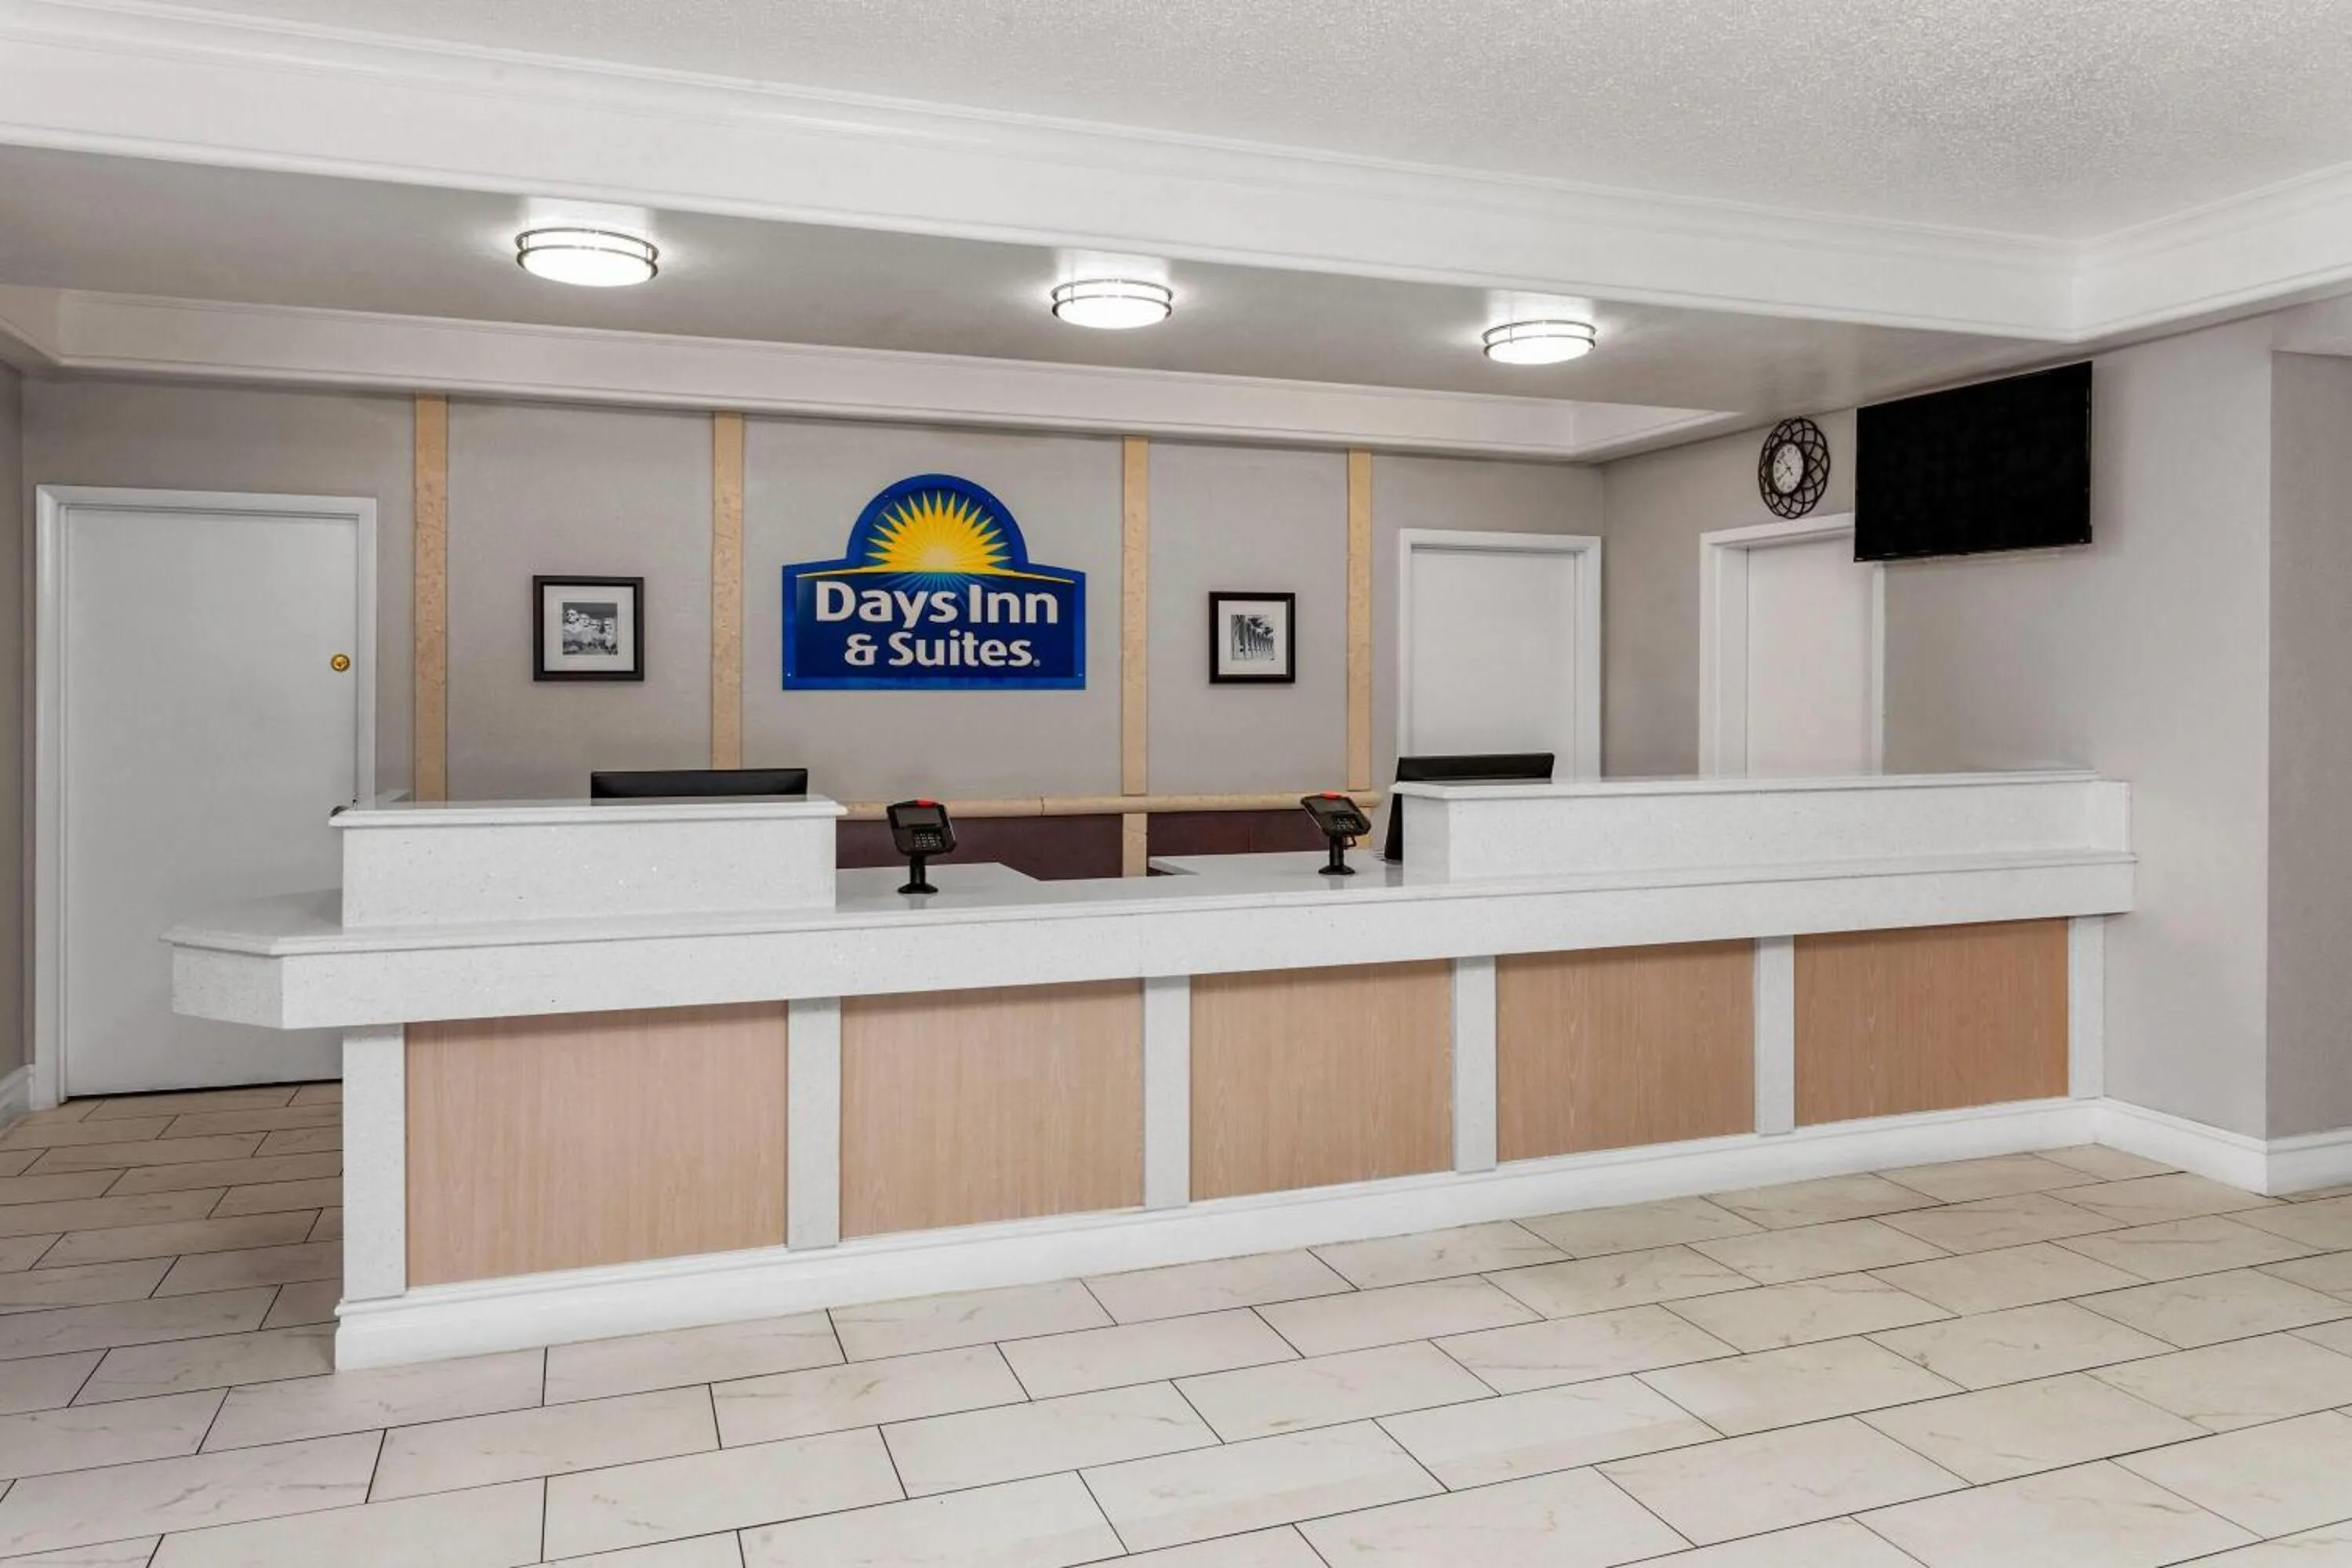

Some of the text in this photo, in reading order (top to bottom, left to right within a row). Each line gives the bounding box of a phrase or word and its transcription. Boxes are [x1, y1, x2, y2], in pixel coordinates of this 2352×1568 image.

[816, 581, 1058, 628] Days Inn
[844, 630, 1031, 666] & Suites
